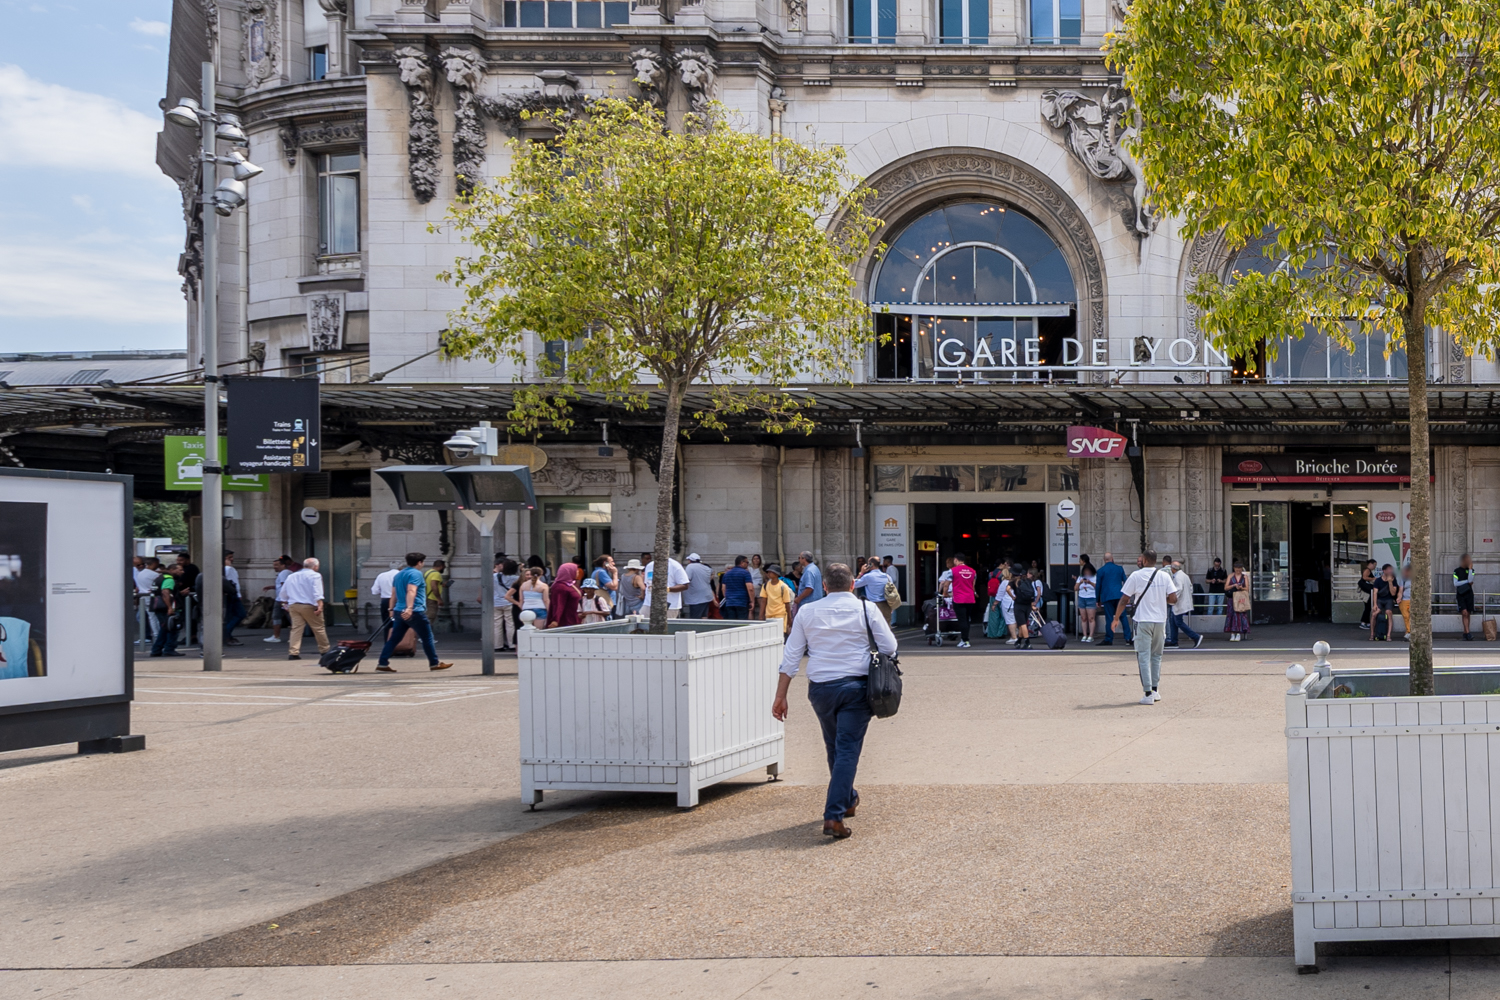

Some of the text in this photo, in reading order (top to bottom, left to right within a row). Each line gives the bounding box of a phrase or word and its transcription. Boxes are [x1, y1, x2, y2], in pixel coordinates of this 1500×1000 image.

[938, 338, 1228, 366] GARE DE LYON
[182, 441, 204, 449] Taxis
[1069, 438, 1122, 454] SNCF
[1296, 459, 1398, 474] Brioche Dorée
